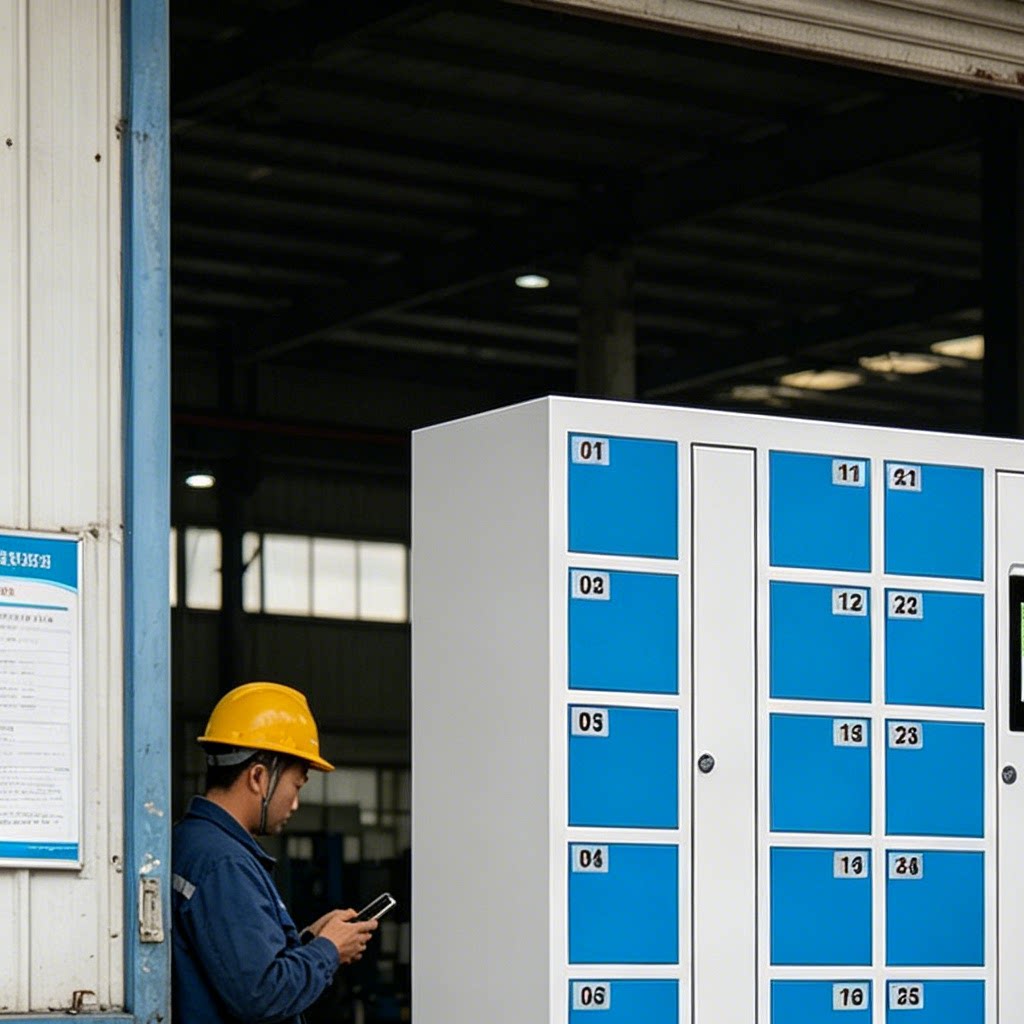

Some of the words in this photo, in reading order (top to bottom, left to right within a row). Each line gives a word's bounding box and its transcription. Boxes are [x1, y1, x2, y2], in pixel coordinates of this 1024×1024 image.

[580, 441, 602, 461] 01
[838, 463, 860, 482] 11
[893, 468, 916, 487] 21
[838, 592, 863, 612] 12
[894, 595, 918, 615] 22
